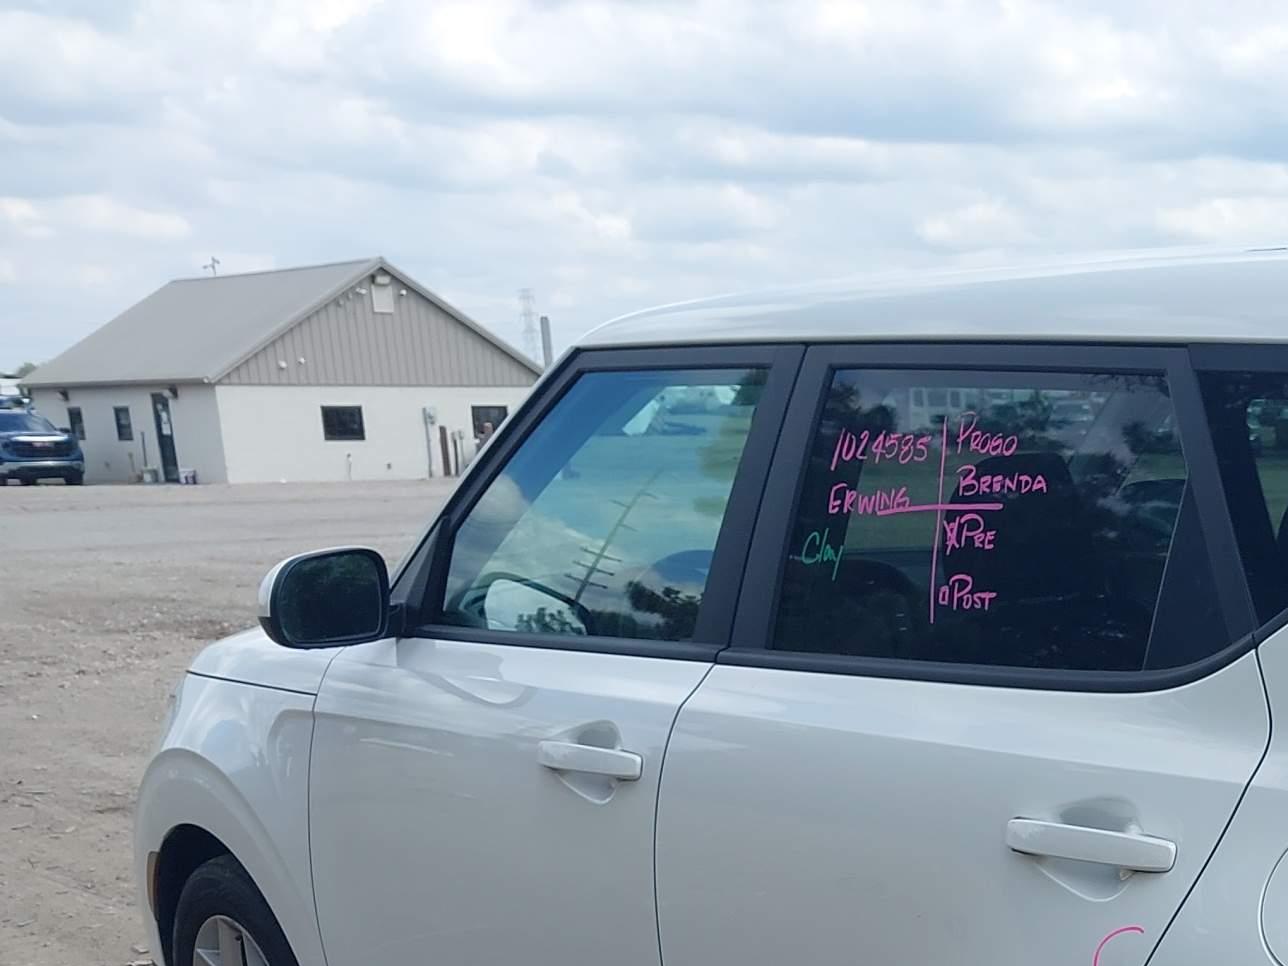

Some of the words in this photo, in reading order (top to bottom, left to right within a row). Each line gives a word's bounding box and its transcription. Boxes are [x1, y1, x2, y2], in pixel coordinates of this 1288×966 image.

[830, 428, 932, 471] 1024585
[956, 464, 1048, 497] BRENDA
[802, 527, 844, 581] Clay
